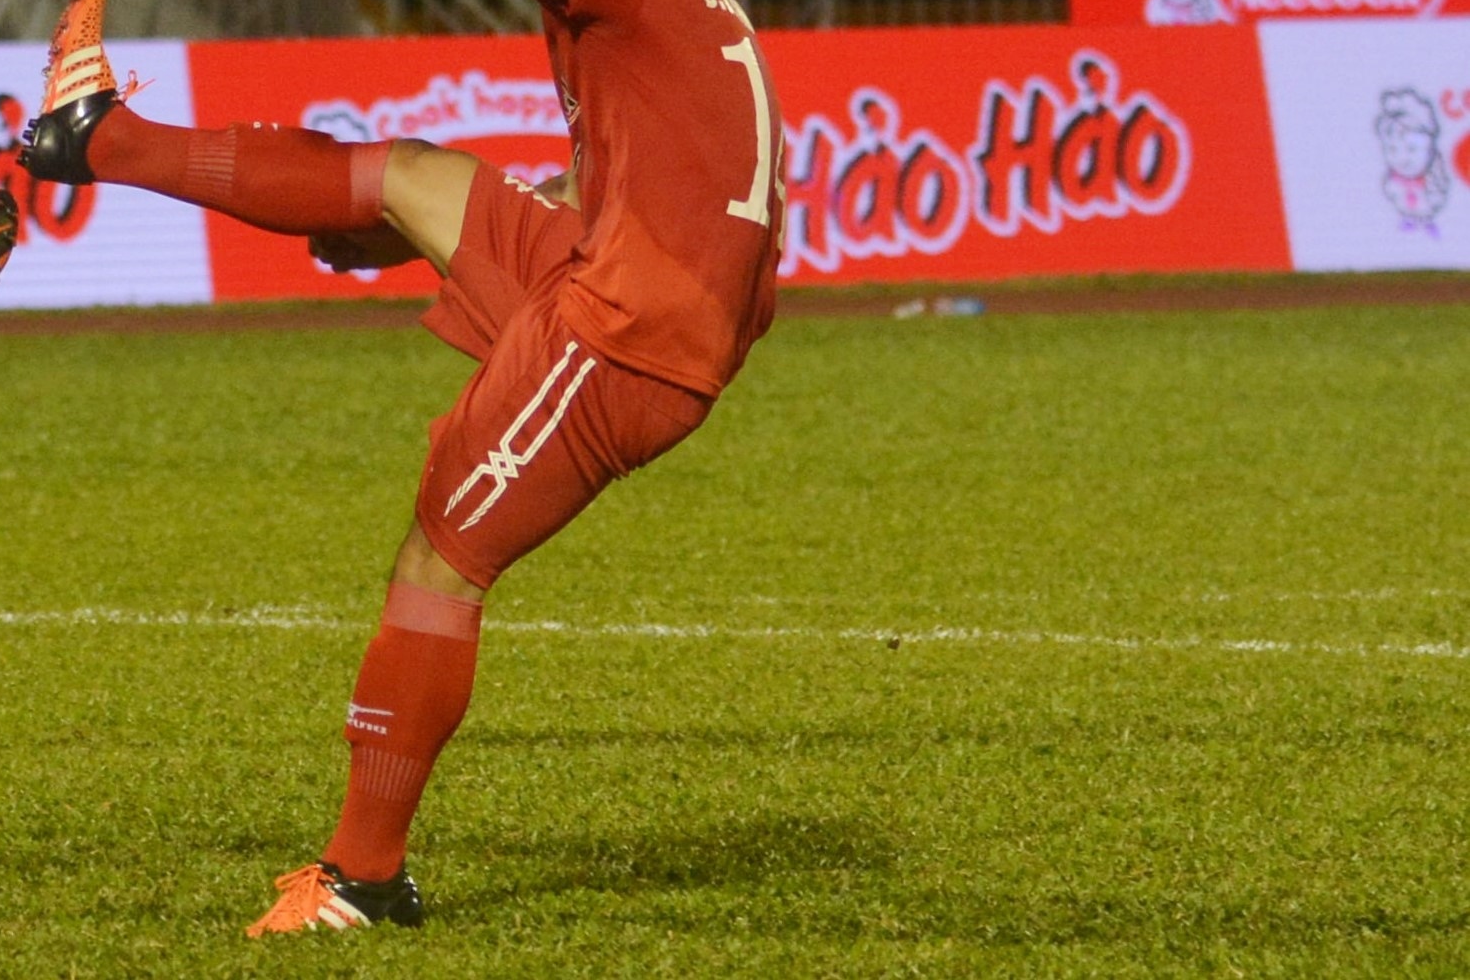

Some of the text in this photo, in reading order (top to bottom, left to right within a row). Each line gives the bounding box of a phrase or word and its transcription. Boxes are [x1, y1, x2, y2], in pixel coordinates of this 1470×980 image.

[375, 86, 562, 139] Cook happ
[720, 35, 782, 229] 1
